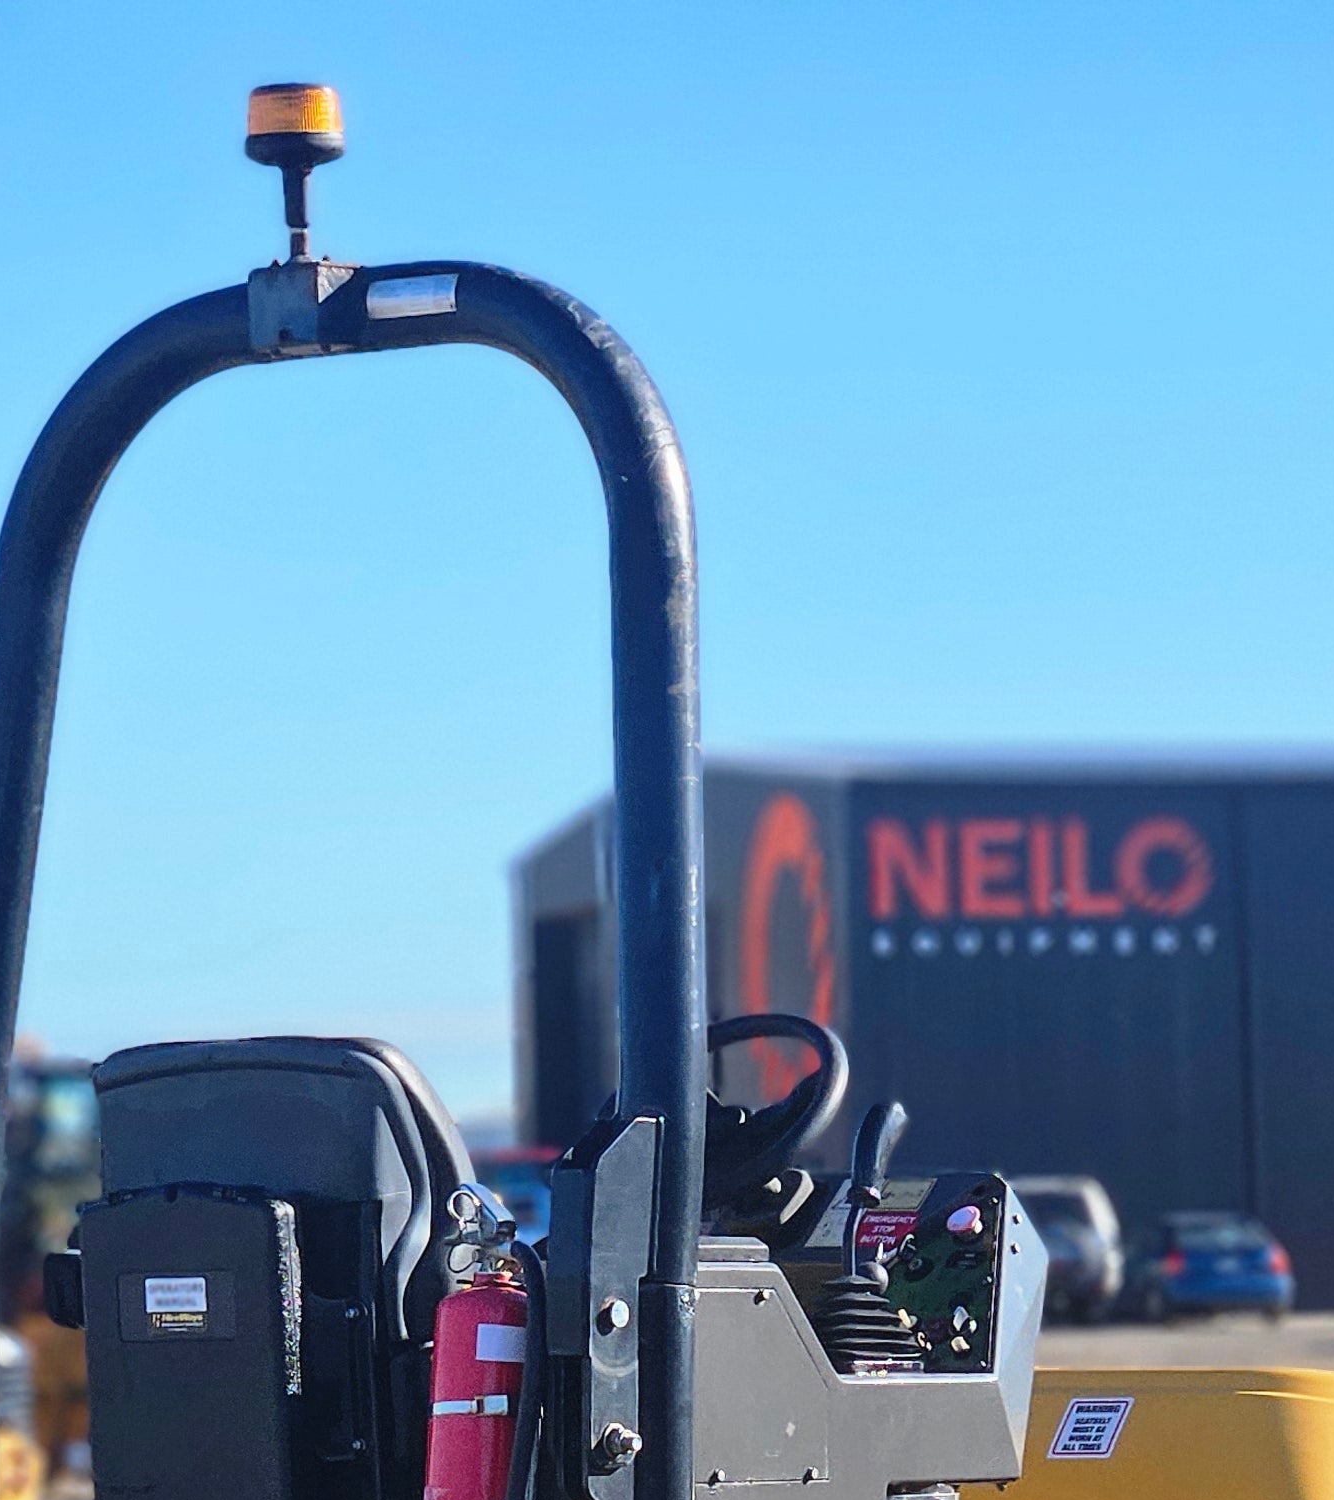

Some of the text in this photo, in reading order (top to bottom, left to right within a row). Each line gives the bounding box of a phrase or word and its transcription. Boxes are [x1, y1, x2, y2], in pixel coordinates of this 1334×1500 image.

[870, 817, 1215, 919] NEILO
[871, 924, 1219, 956] EQUIPMENT
[863, 1215, 917, 1224] EMERGENCY
[872, 1225, 895, 1233] STOP
[860, 1234, 897, 1245] BUTTON
[1075, 1405, 1121, 1413] WARNING
[1061, 1443, 1102, 1451] ALL TIMES
